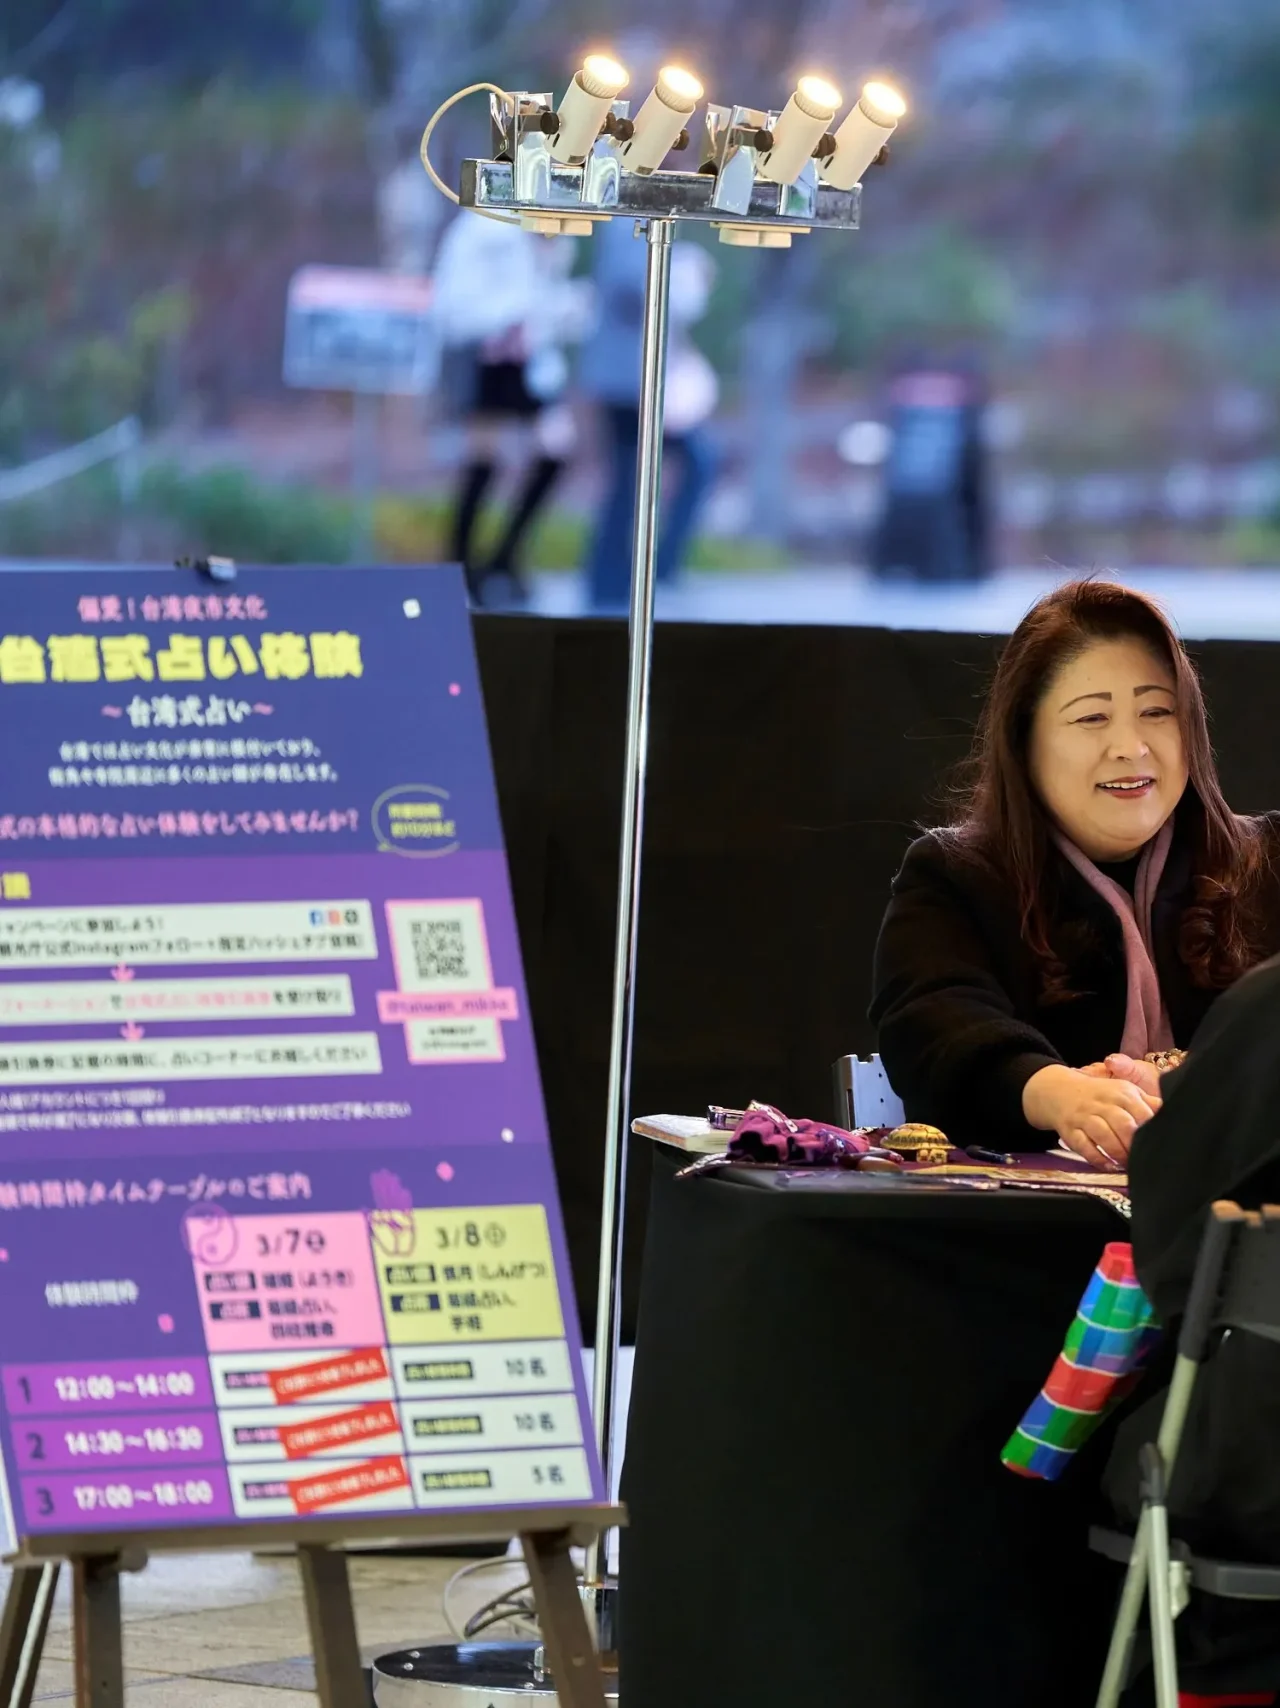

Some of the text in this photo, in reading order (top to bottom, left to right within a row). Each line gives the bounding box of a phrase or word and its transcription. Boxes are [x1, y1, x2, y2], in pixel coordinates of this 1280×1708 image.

[18, 1376, 31, 1405] 1
[27, 1433, 46, 1460] 2
[37, 1486, 54, 1516] 3
